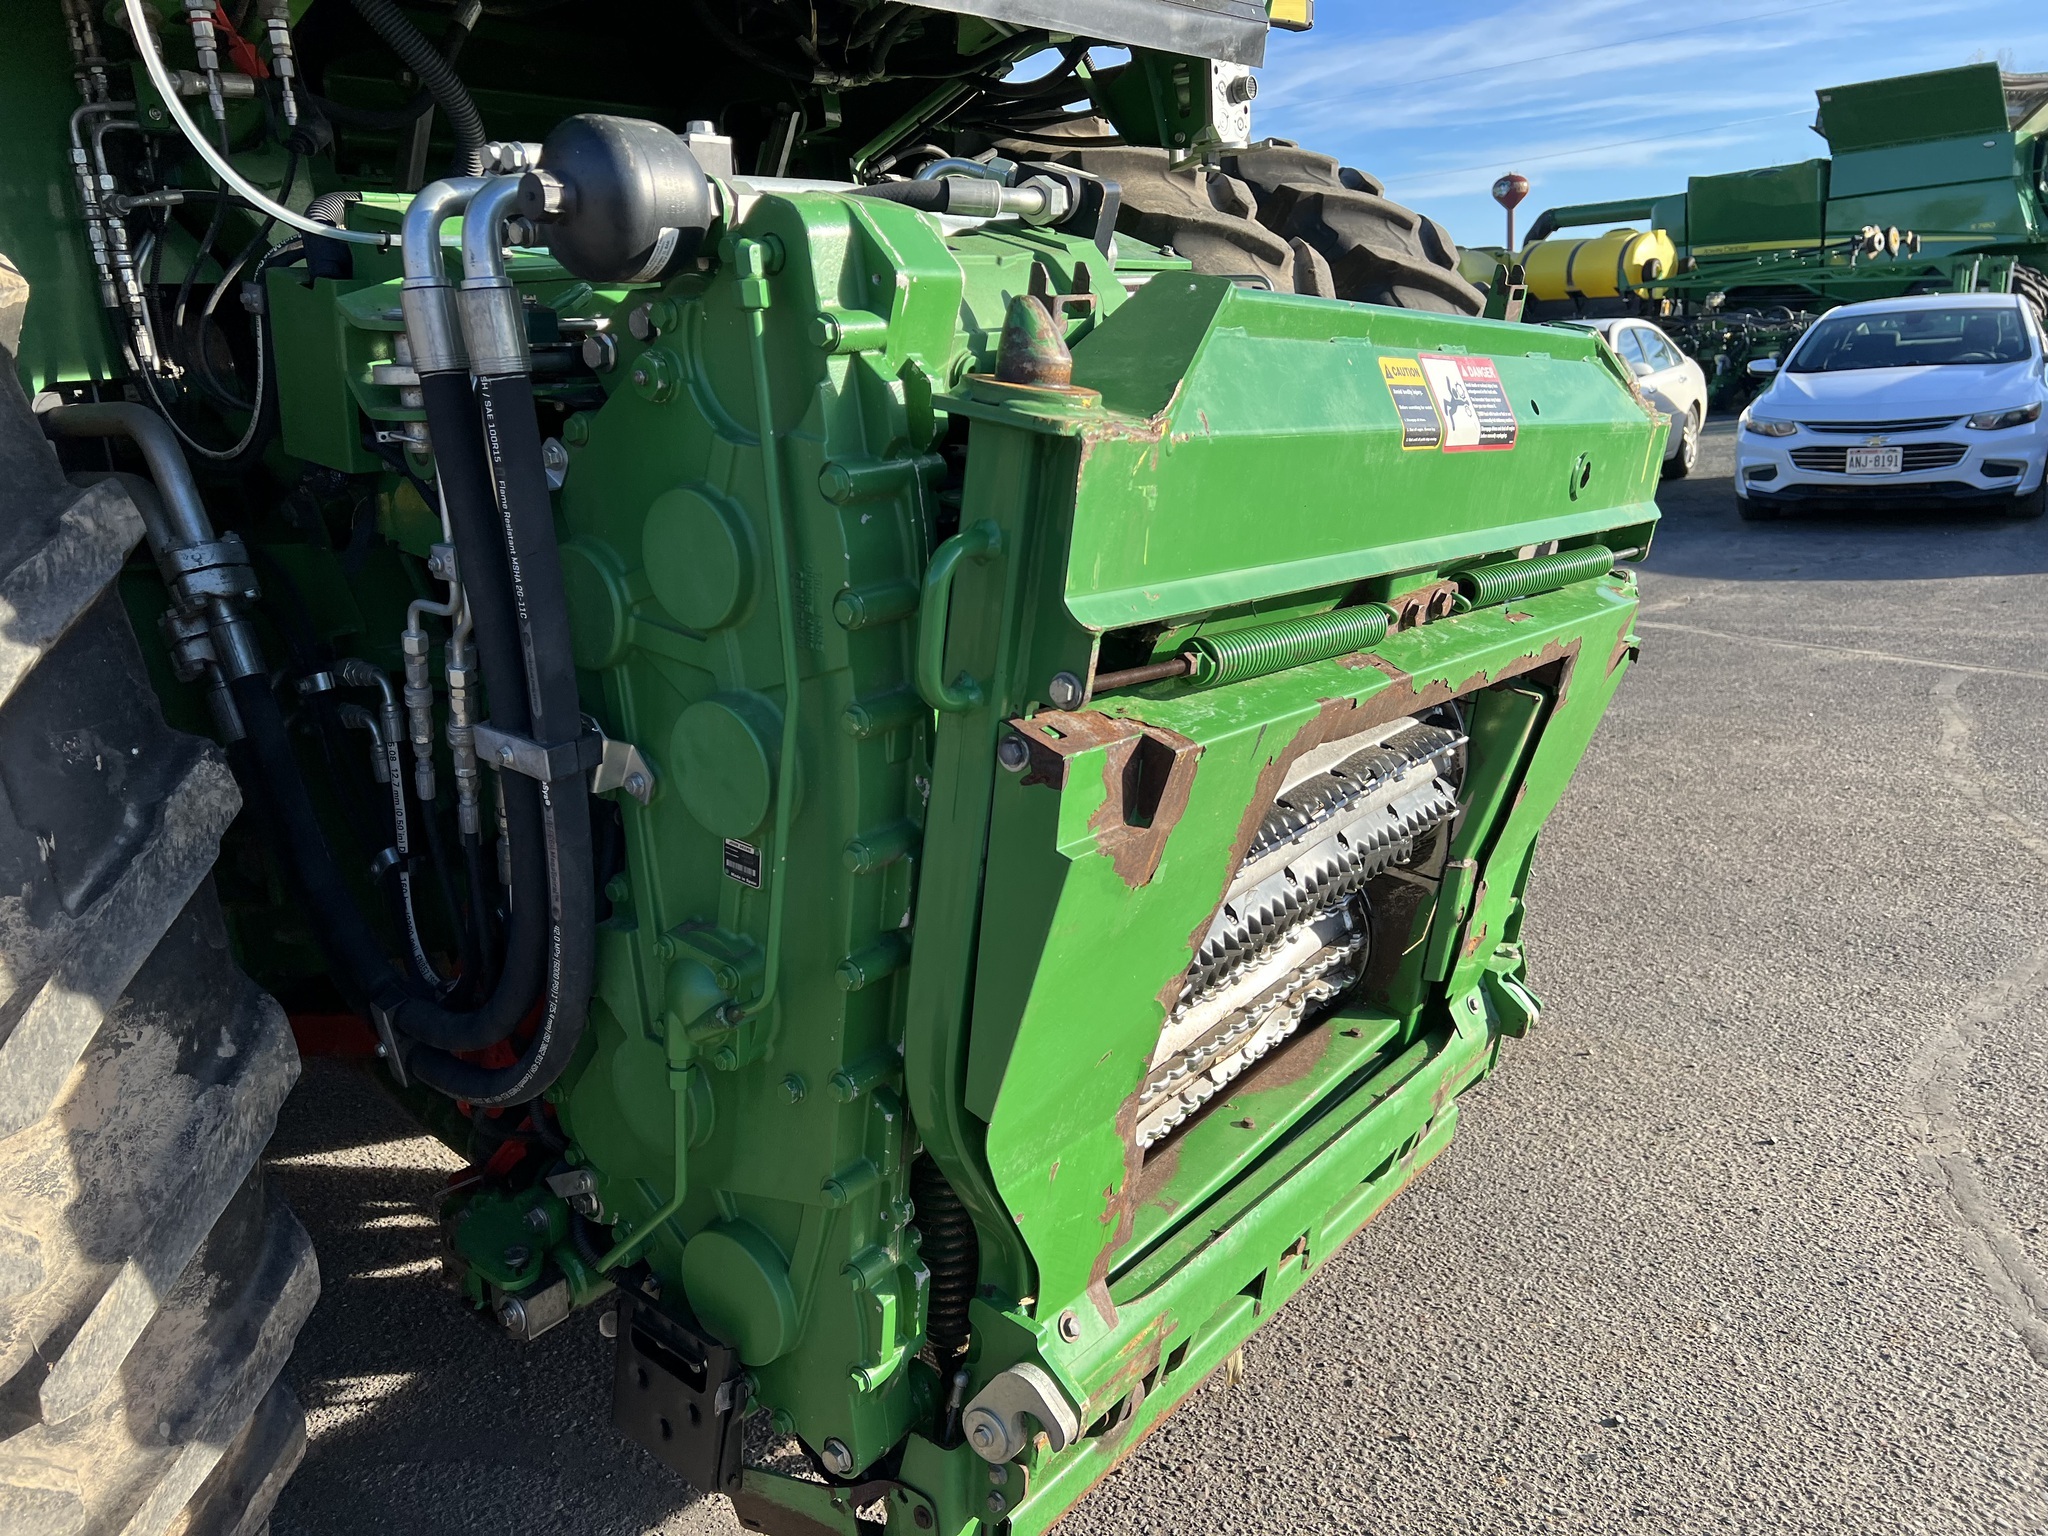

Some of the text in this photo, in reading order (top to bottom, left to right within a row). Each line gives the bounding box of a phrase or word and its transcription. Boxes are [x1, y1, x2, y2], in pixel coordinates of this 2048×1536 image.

[1392, 367, 1420, 378] CAUTION
[1468, 365, 1496, 378] DANGER
[483, 399, 494, 420] SAE
[488, 422, 501, 463] 100R15
[1849, 455, 1898, 468] ANJ-8191
[497, 480, 509, 510] Flame
[503, 511, 516, 555] Resistant
[510, 556, 521, 583] MSHA
[514, 583, 528, 619] 2G-11C
[390, 767, 400, 787] 12.7
[393, 789, 400, 805] mm
[553, 941, 561, 957] MPa
[414, 953, 430, 976] EN857
[550, 957, 560, 980] (6000
[549, 979, 559, 994] PSI)
[541, 1031, 551, 1043] ISO
